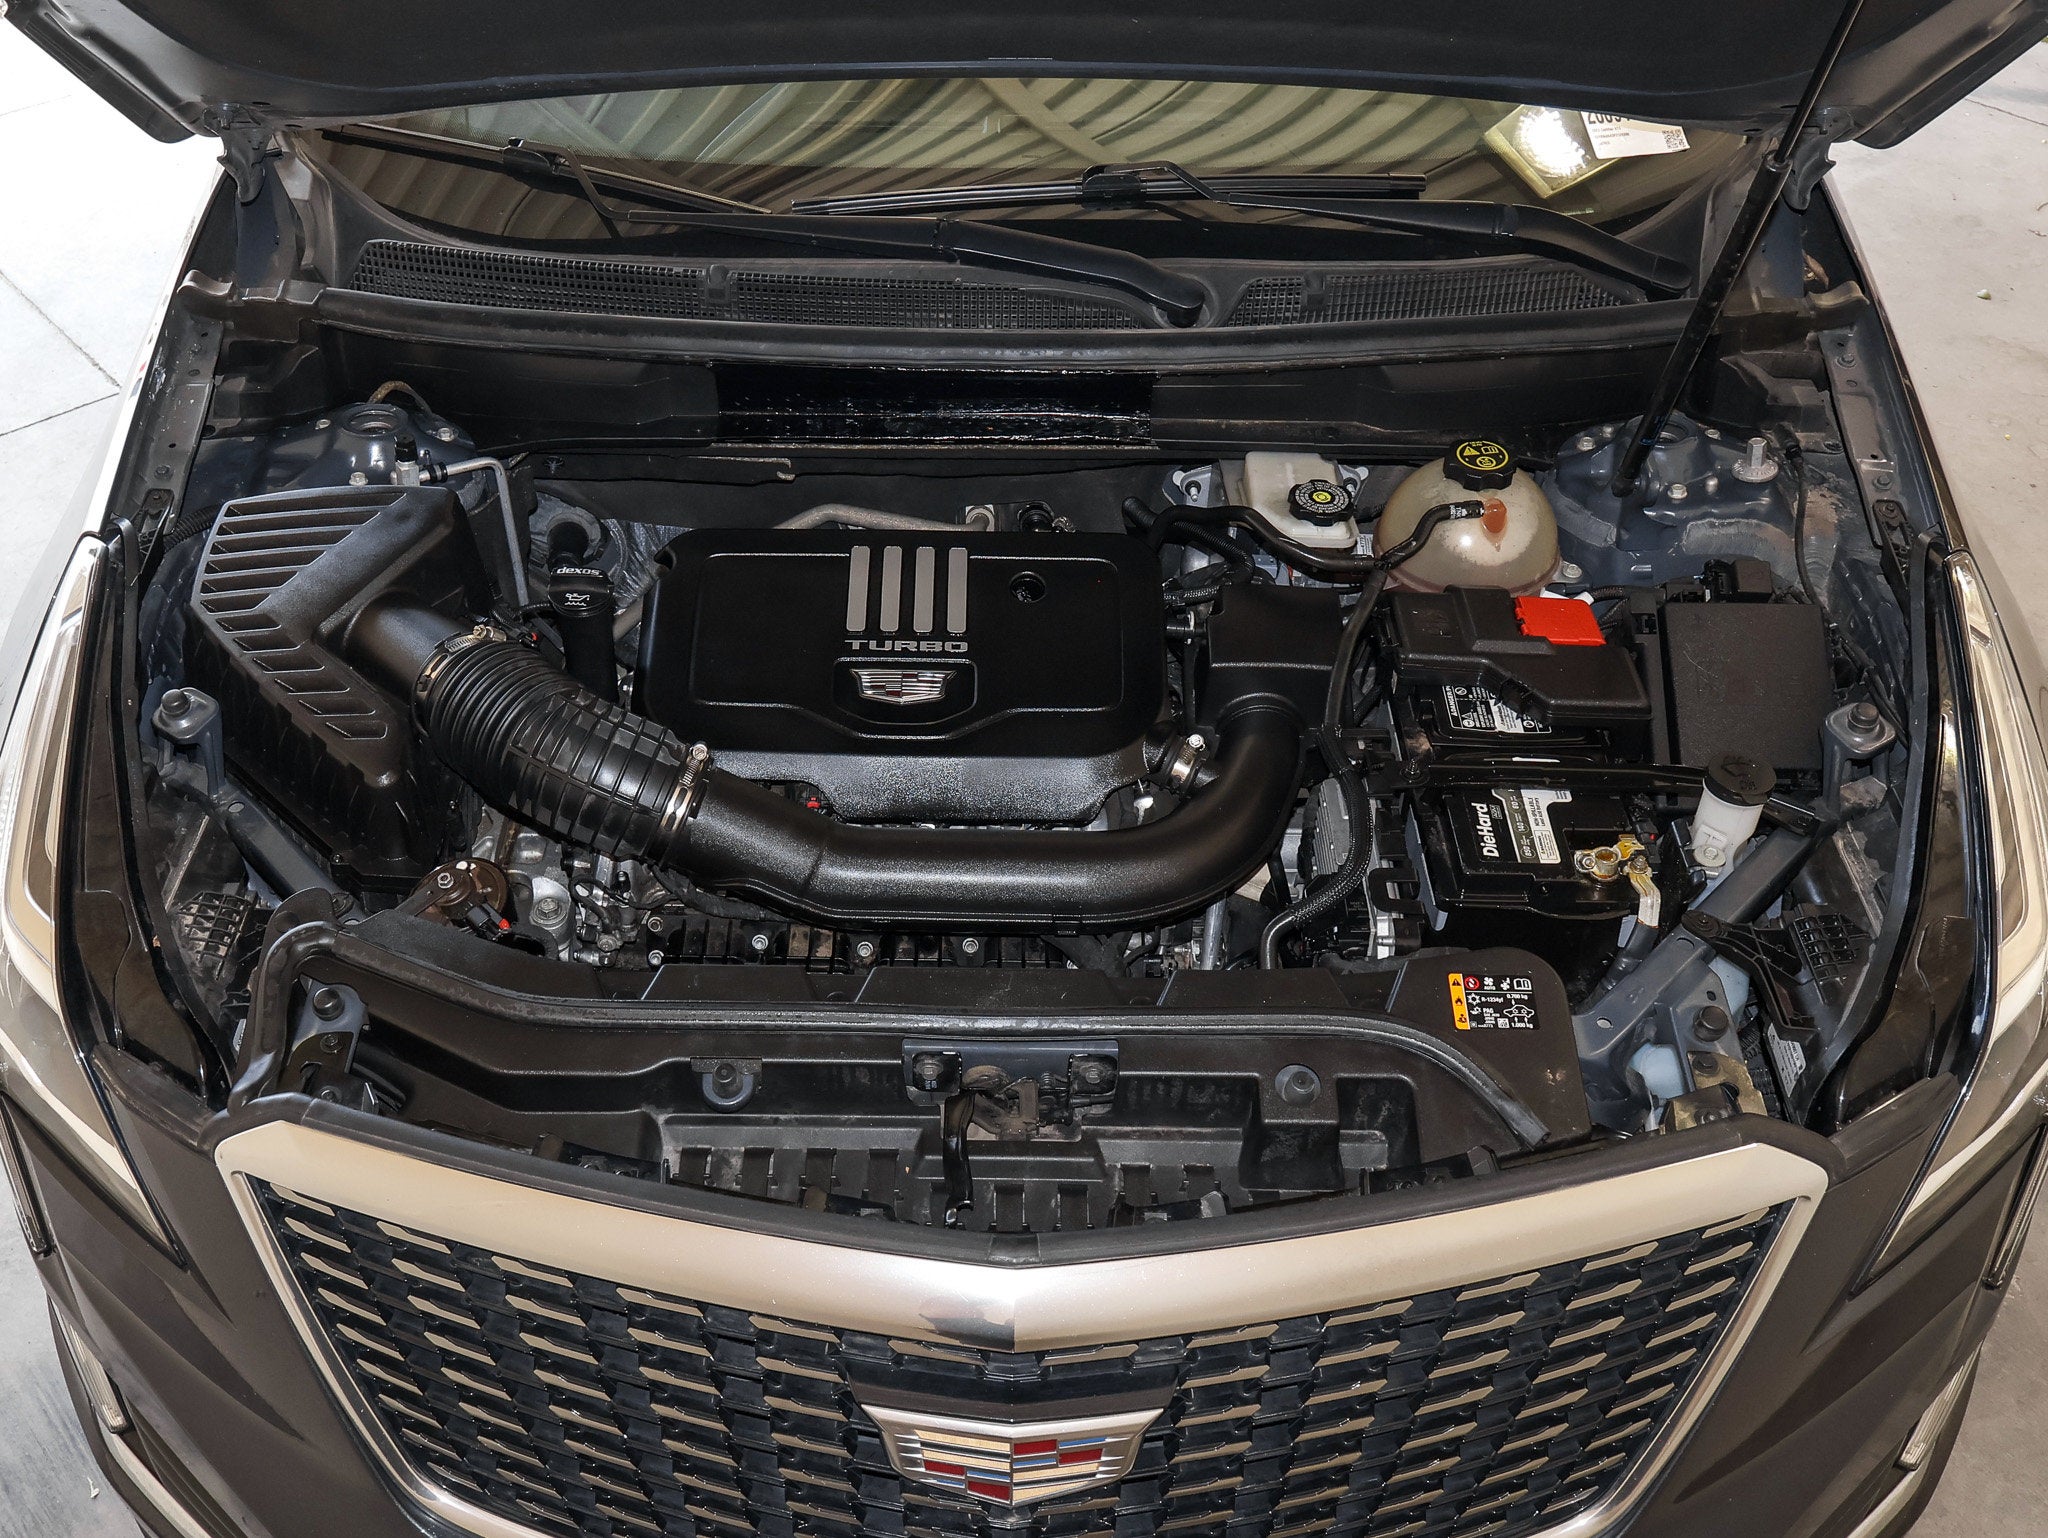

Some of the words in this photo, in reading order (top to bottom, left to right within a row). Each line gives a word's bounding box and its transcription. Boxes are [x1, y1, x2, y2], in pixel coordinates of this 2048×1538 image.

[556, 566, 601, 576] dexos
[844, 639, 969, 653] TURBO
[1471, 803, 1500, 857] DieHard
